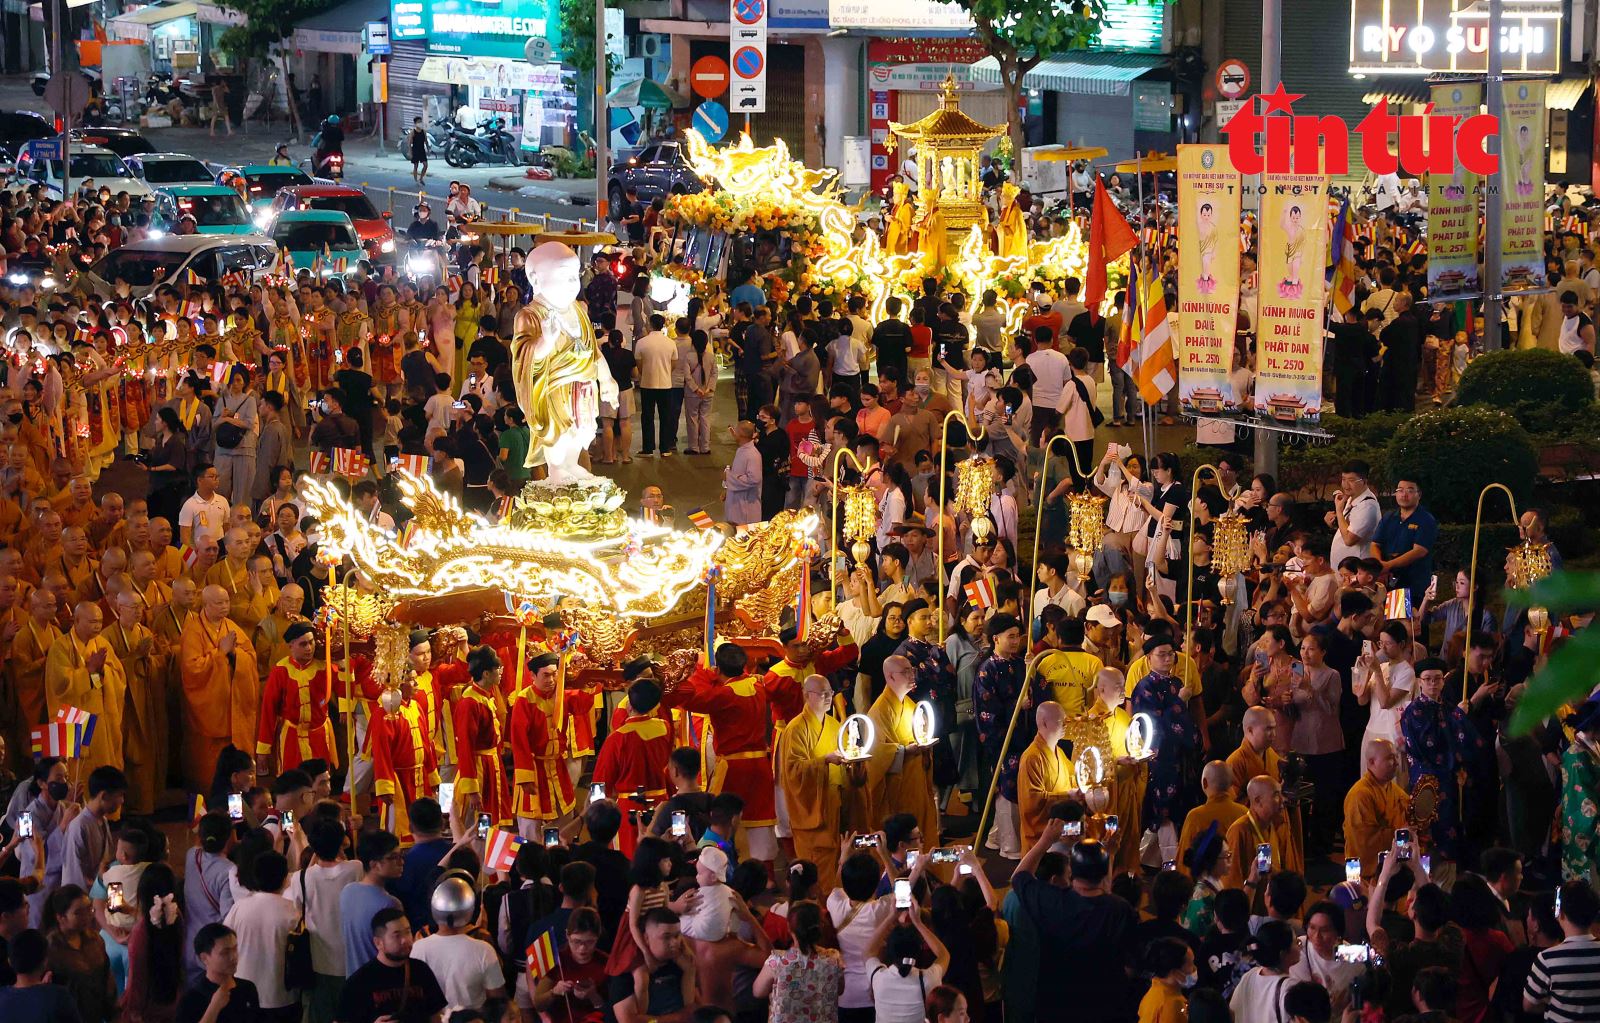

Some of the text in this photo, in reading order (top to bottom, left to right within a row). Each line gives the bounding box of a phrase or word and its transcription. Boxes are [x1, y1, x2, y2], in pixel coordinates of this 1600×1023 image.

[1362, 24, 1435, 54] RYO
[1185, 334, 1209, 349] PHẬT
[1189, 352, 1204, 364] PL.
[1267, 357, 1304, 371] PL. 2570
